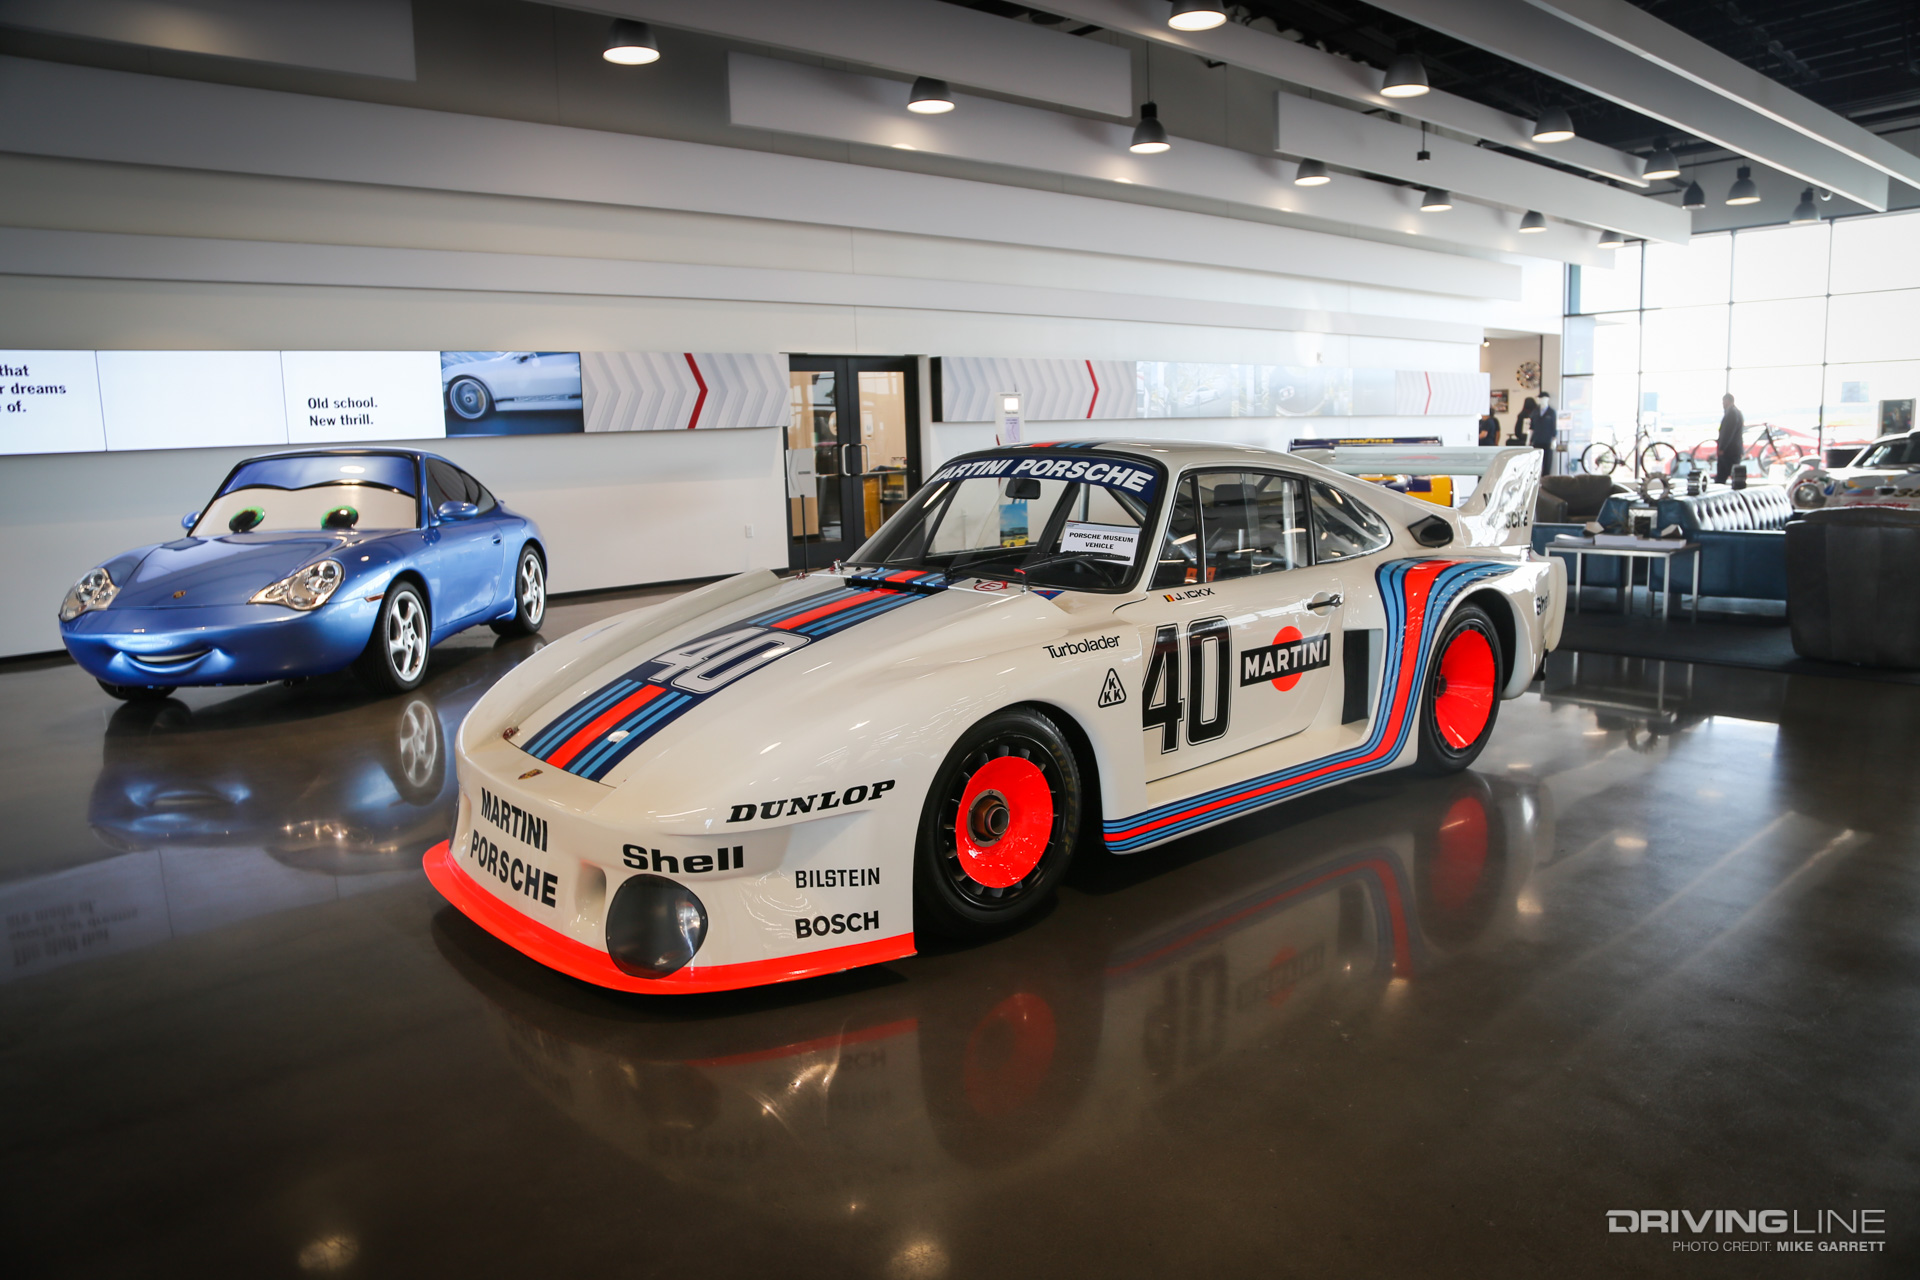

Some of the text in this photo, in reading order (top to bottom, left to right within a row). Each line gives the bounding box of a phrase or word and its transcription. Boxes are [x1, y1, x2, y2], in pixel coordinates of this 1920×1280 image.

[0, 364, 29, 377] that
[10, 382, 66, 395] dreams
[7, 400, 27, 413] of.
[307, 396, 378, 409] Old school.
[309, 413, 374, 426] New thrill.
[1011, 459, 1154, 493] PORSCHE
[1069, 532, 1134, 543] PORSCHE MUSEUM
[1085, 541, 1115, 550] VEHICLE
[1175, 587, 1216, 601] J. ICKX
[1043, 635, 1121, 659] Turbolader
[1244, 638, 1328, 680] MARTINI
[647, 626, 812, 694] 40
[1142, 615, 1232, 755] 40
[726, 779, 896, 823] DUNLOP
[481, 786, 549, 853] MARTINI
[470, 828, 559, 909] PORSCHE
[622, 843, 744, 874] Shell
[795, 867, 881, 889] BILSTEIN
[795, 910, 880, 939] BOSCH
